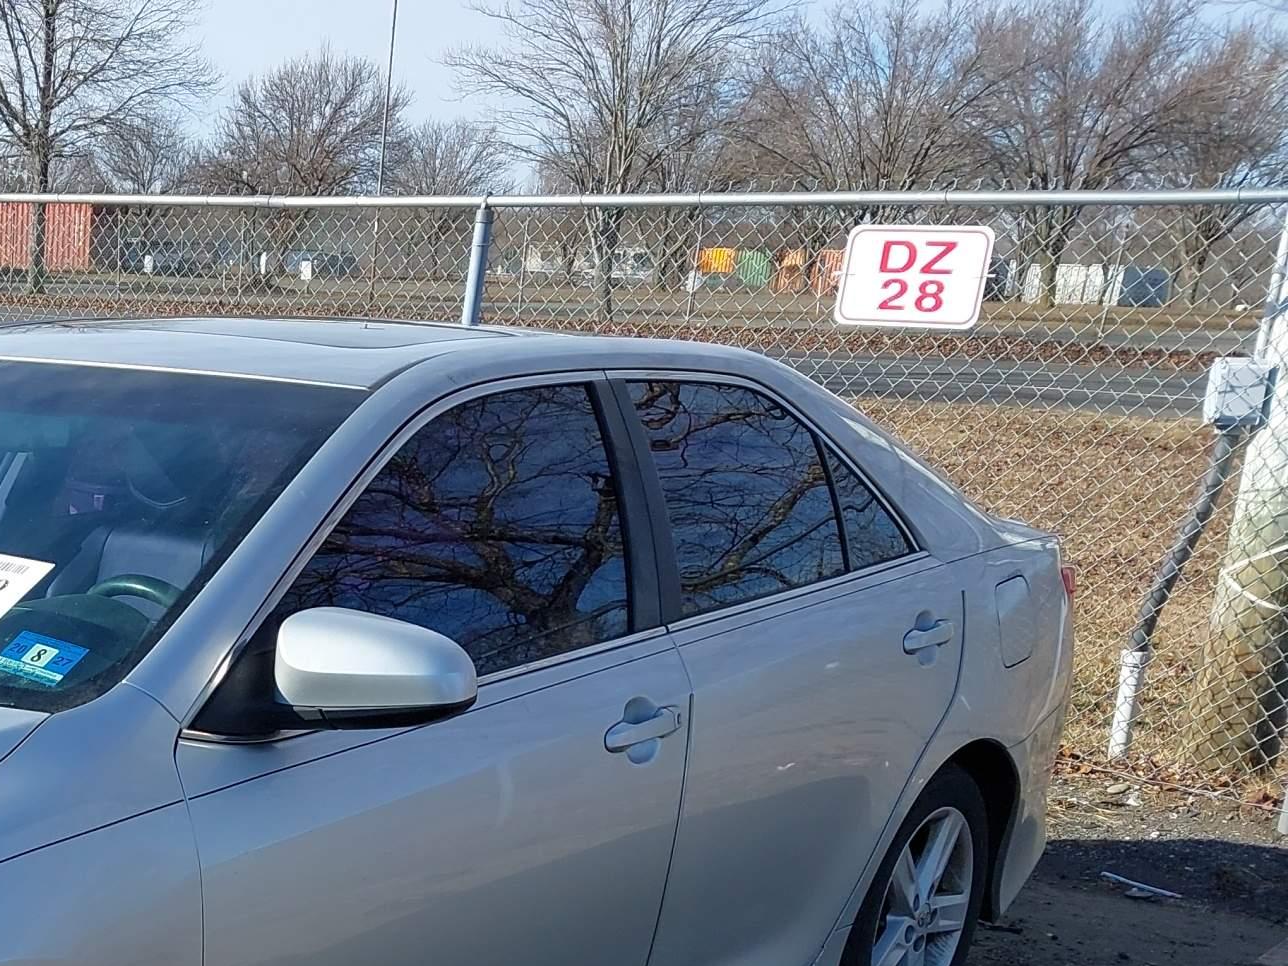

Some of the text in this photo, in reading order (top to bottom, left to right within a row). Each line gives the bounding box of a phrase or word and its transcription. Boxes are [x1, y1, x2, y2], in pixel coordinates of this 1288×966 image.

[878, 239, 959, 275] DZ
[876, 278, 945, 313] 28
[30, 648, 48, 663] 8
